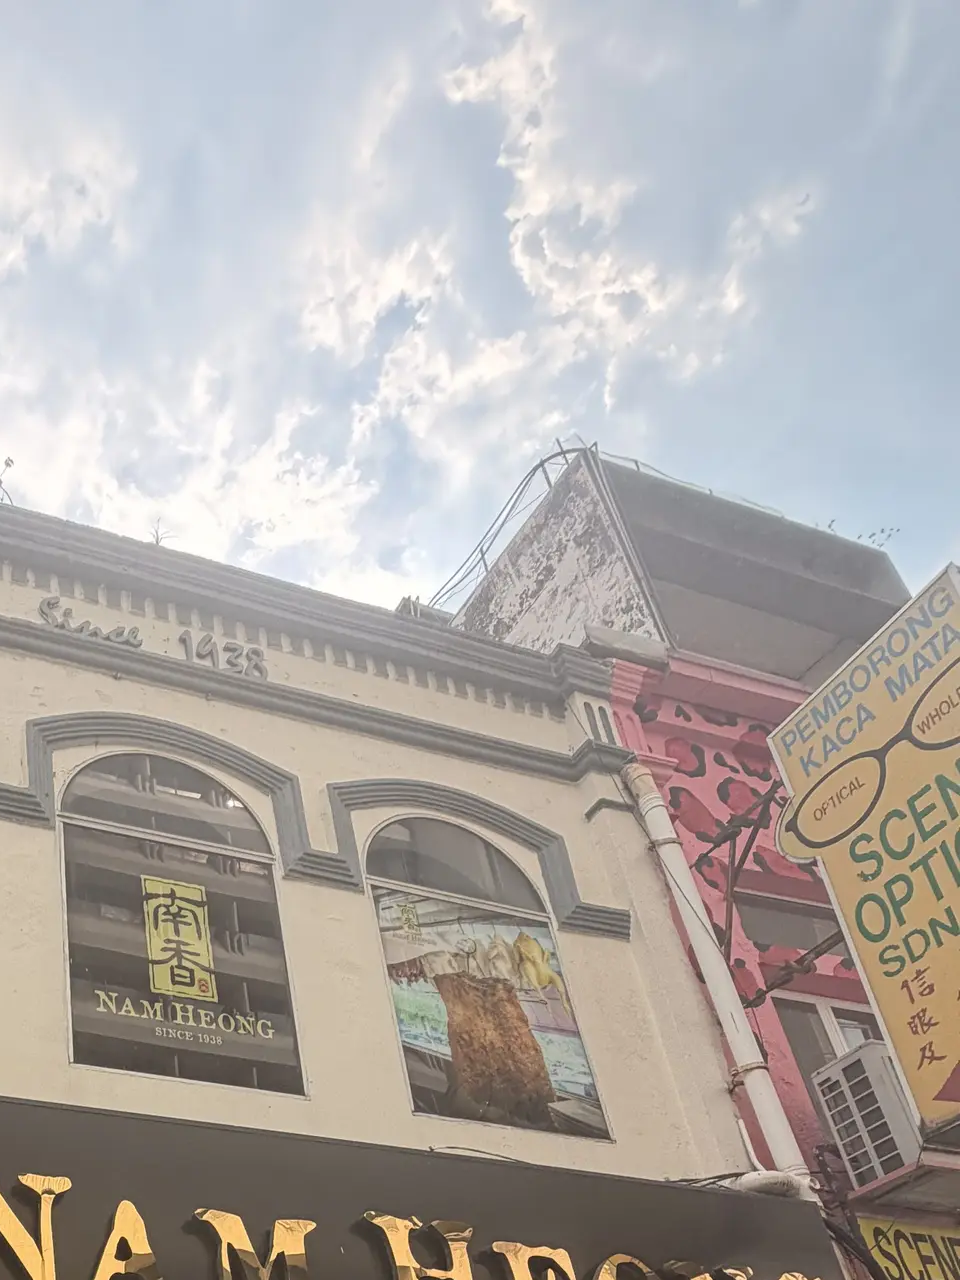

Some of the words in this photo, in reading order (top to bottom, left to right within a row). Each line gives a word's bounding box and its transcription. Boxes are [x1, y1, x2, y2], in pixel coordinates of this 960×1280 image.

[179, 629, 268, 682] 1938
[780, 586, 955, 756] PEMBORONG
[798, 702, 876, 778] KACA
[883, 622, 960, 703] MATA
[813, 776, 866, 822] OPTICAL
[854, 828, 960, 943] OPTI
[877, 906, 960, 977] SDN
[94, 989, 165, 1022] NAM
[171, 1002, 276, 1040] HEONG
[155, 1027, 194, 1041] SINCE
[198, 1033, 224, 1046] 1938
